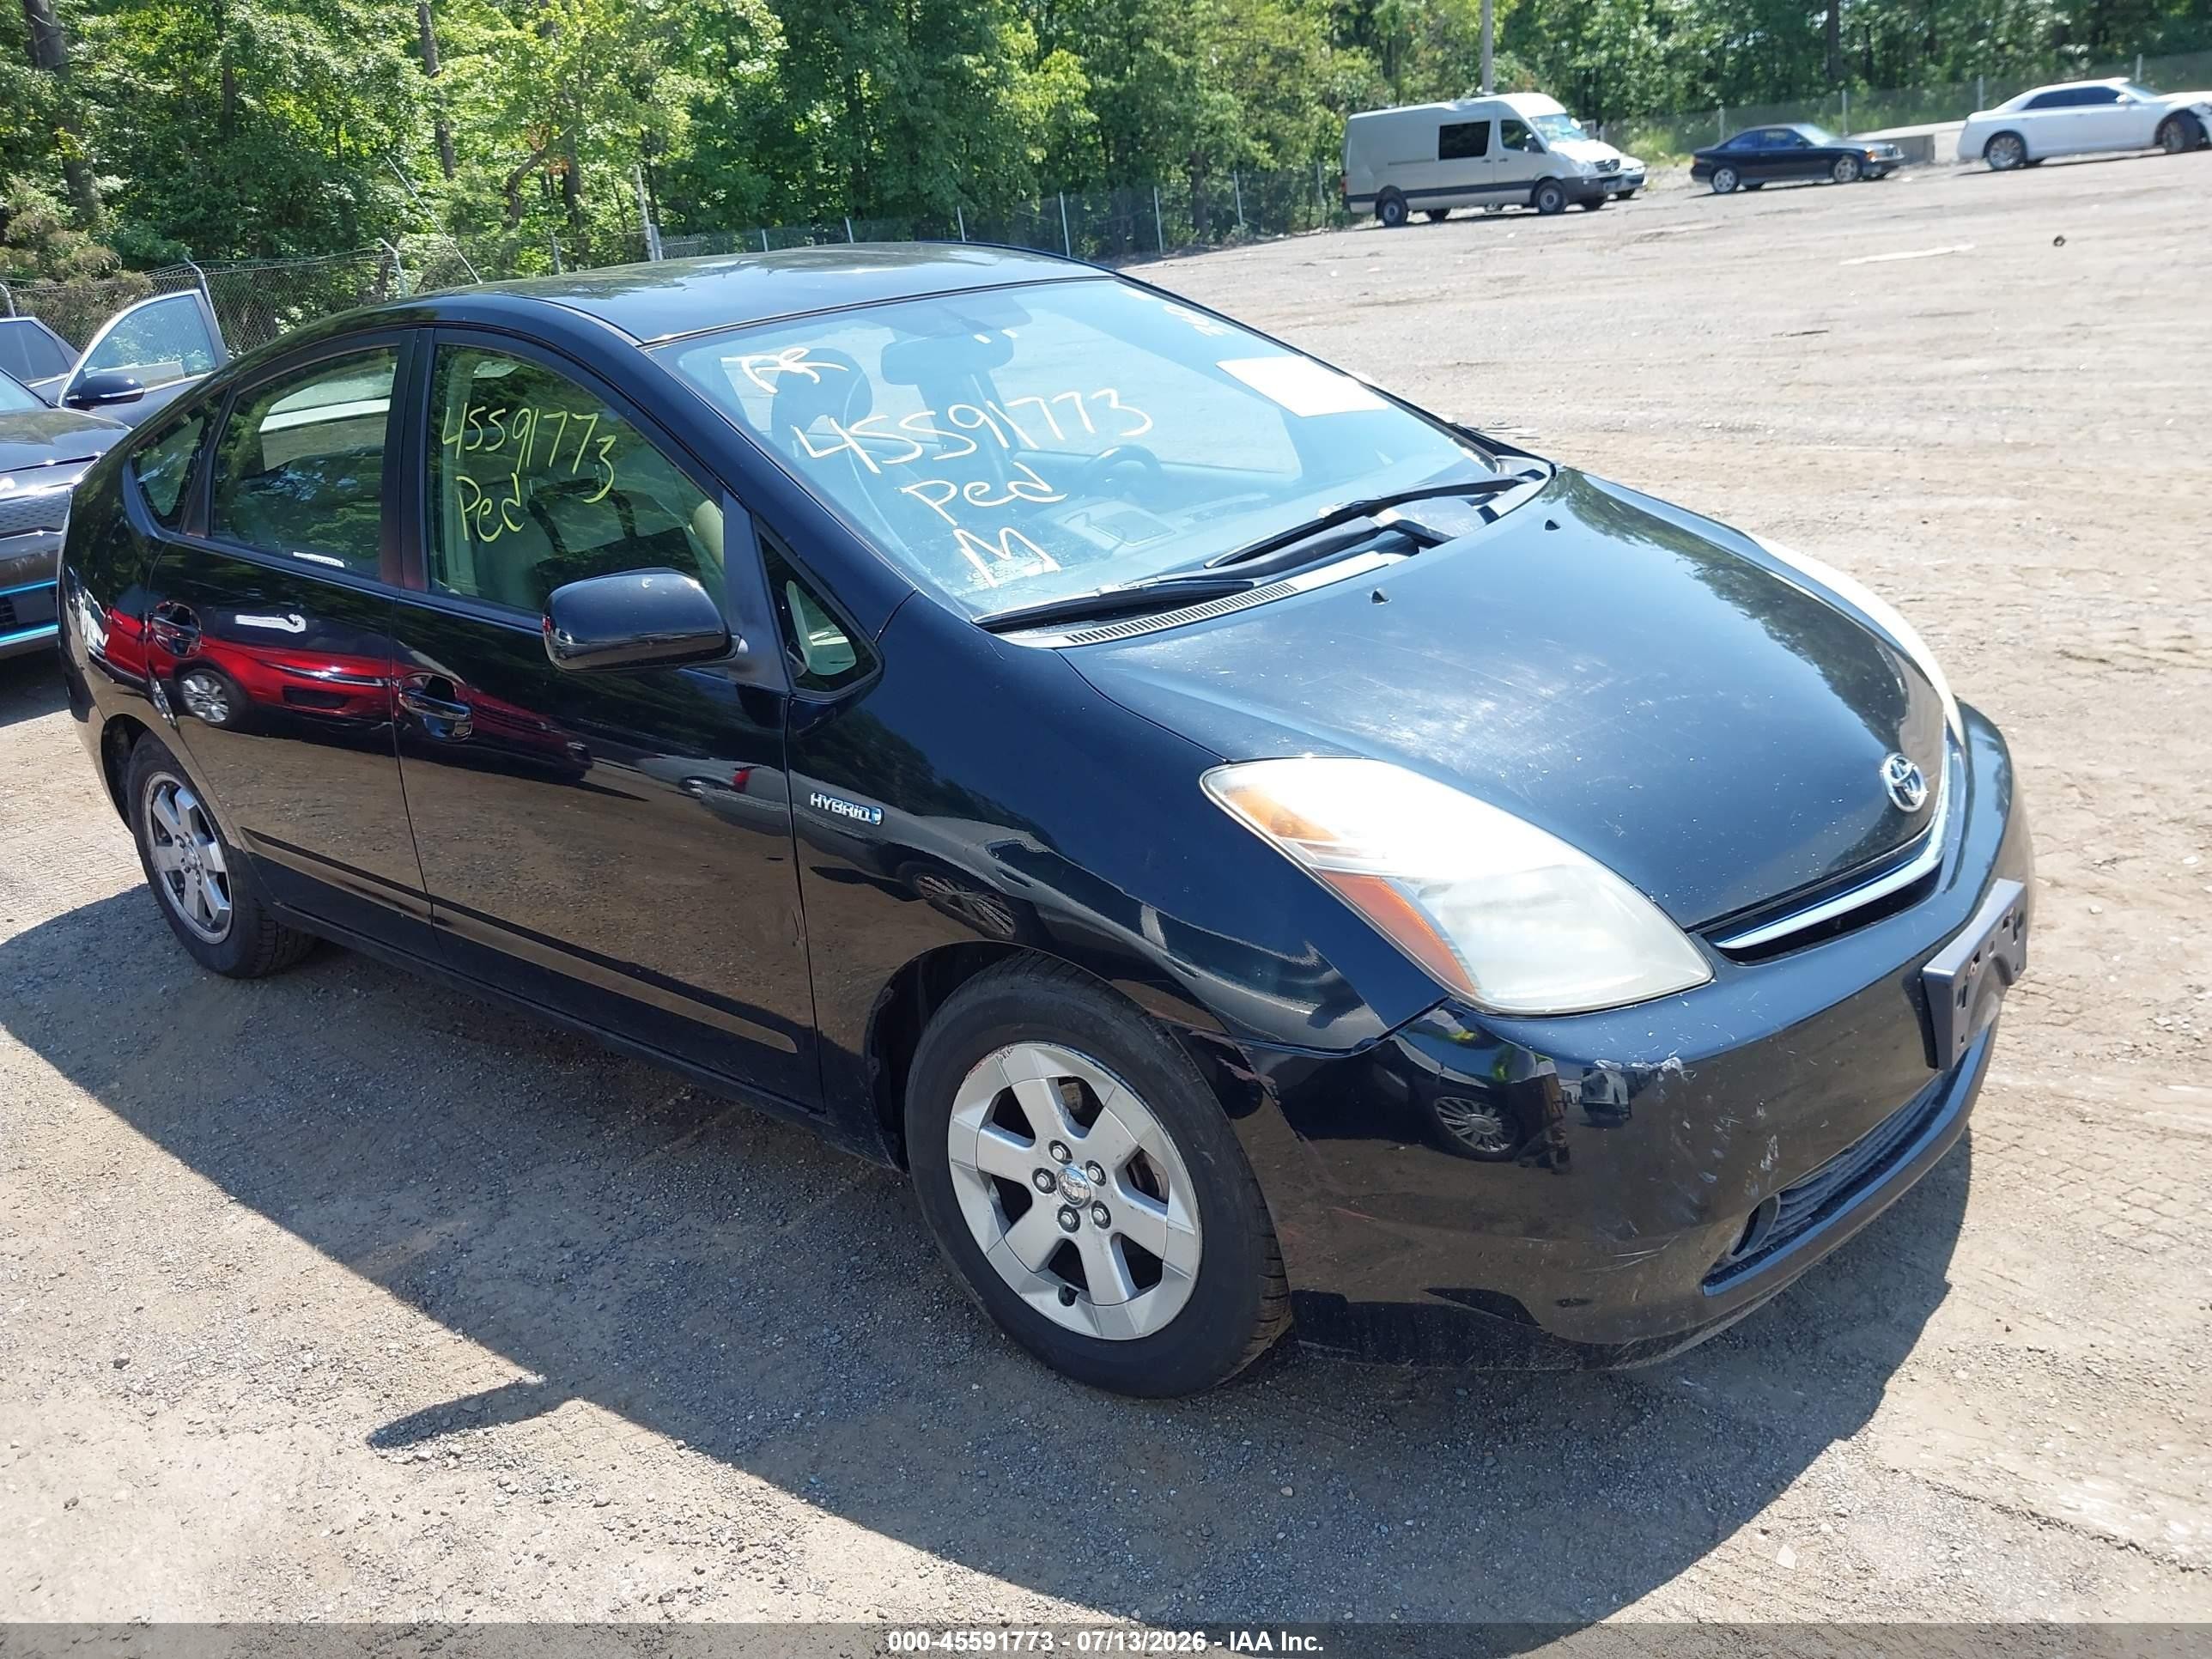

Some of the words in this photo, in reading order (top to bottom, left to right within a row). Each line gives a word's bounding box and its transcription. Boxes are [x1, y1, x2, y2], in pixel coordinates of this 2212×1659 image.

[442, 402, 617, 503] 45591773
[794, 388, 1153, 473] 45591773
[456, 472, 525, 542] Ped
[895, 462, 1067, 526] Ped
[953, 526, 1061, 588] M
[810, 792, 872, 822] HYBRID
